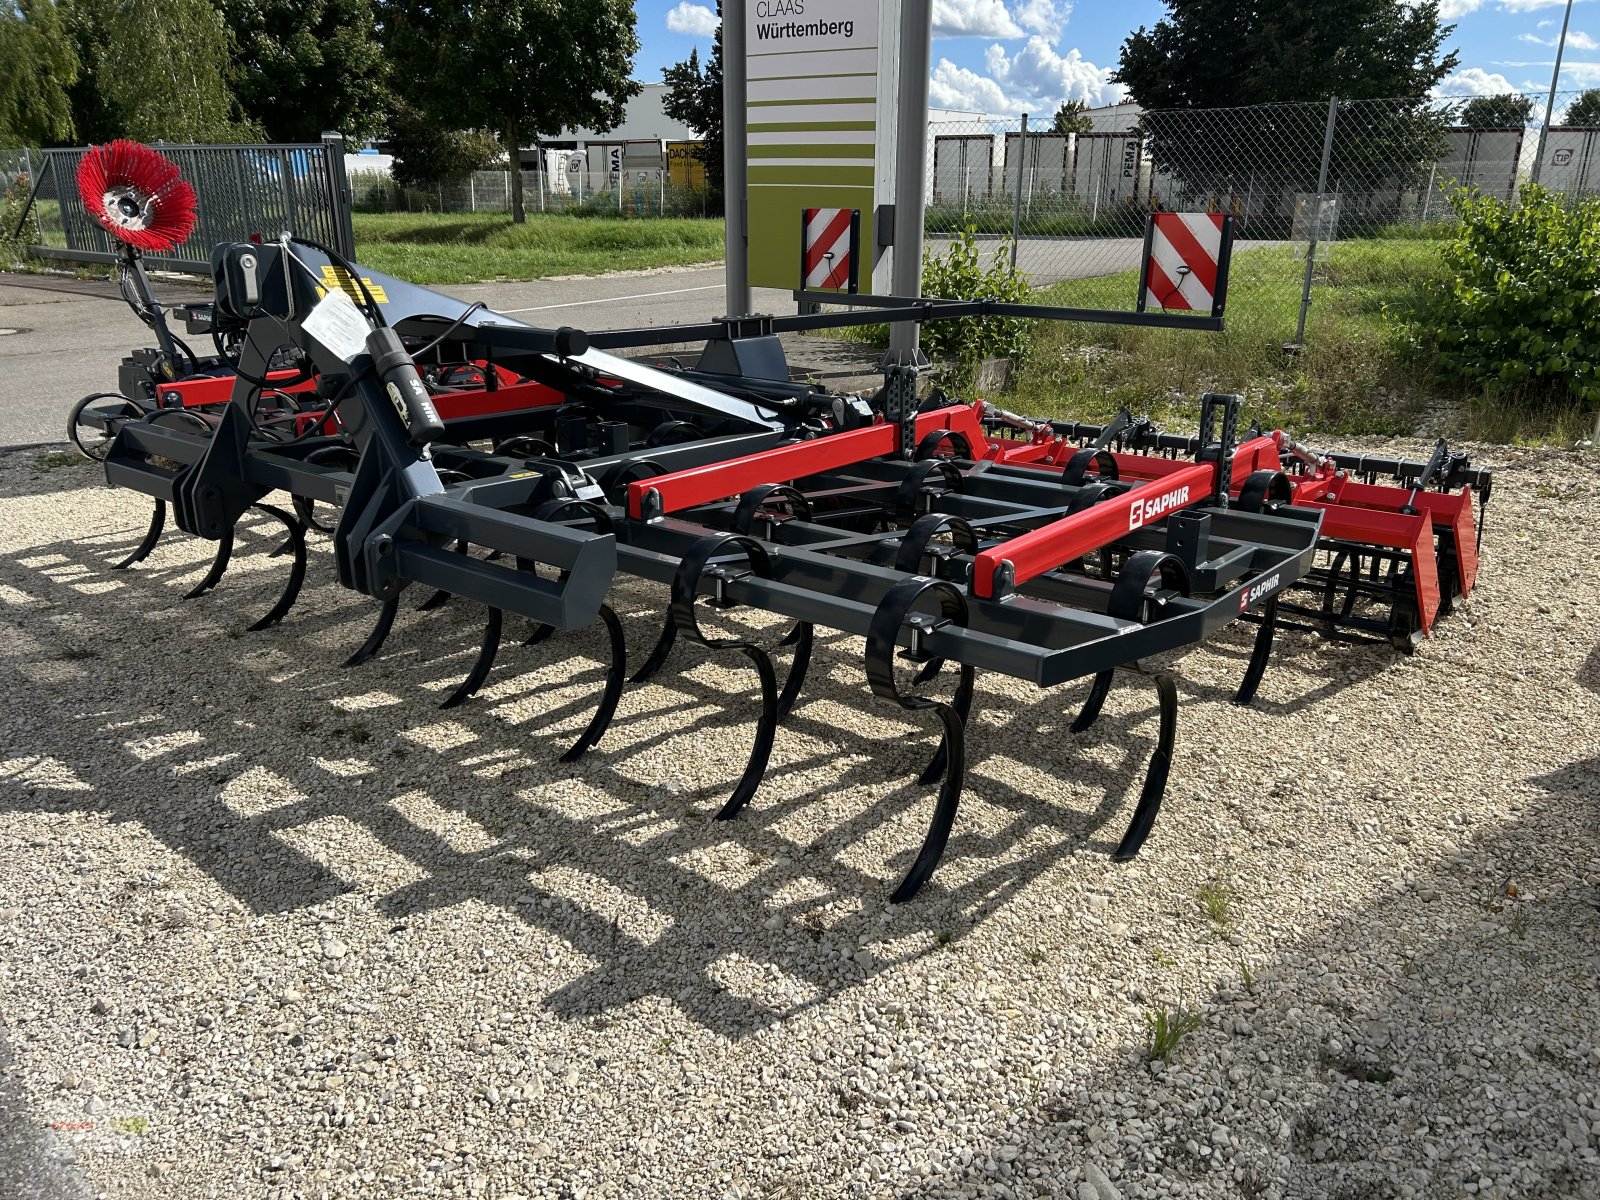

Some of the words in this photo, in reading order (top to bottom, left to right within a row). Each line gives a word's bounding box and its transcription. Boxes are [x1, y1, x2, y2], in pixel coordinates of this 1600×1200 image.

[757, 0, 804, 18] CLAAS
[757, 19, 854, 40] Württemberg
[1123, 141, 1136, 178] PEMA
[1555, 154, 1570, 162] TIP
[409, 379, 438, 423] SAHIR
[1144, 485, 1190, 519] SAPHIR
[1249, 573, 1280, 602] SAPHIR
